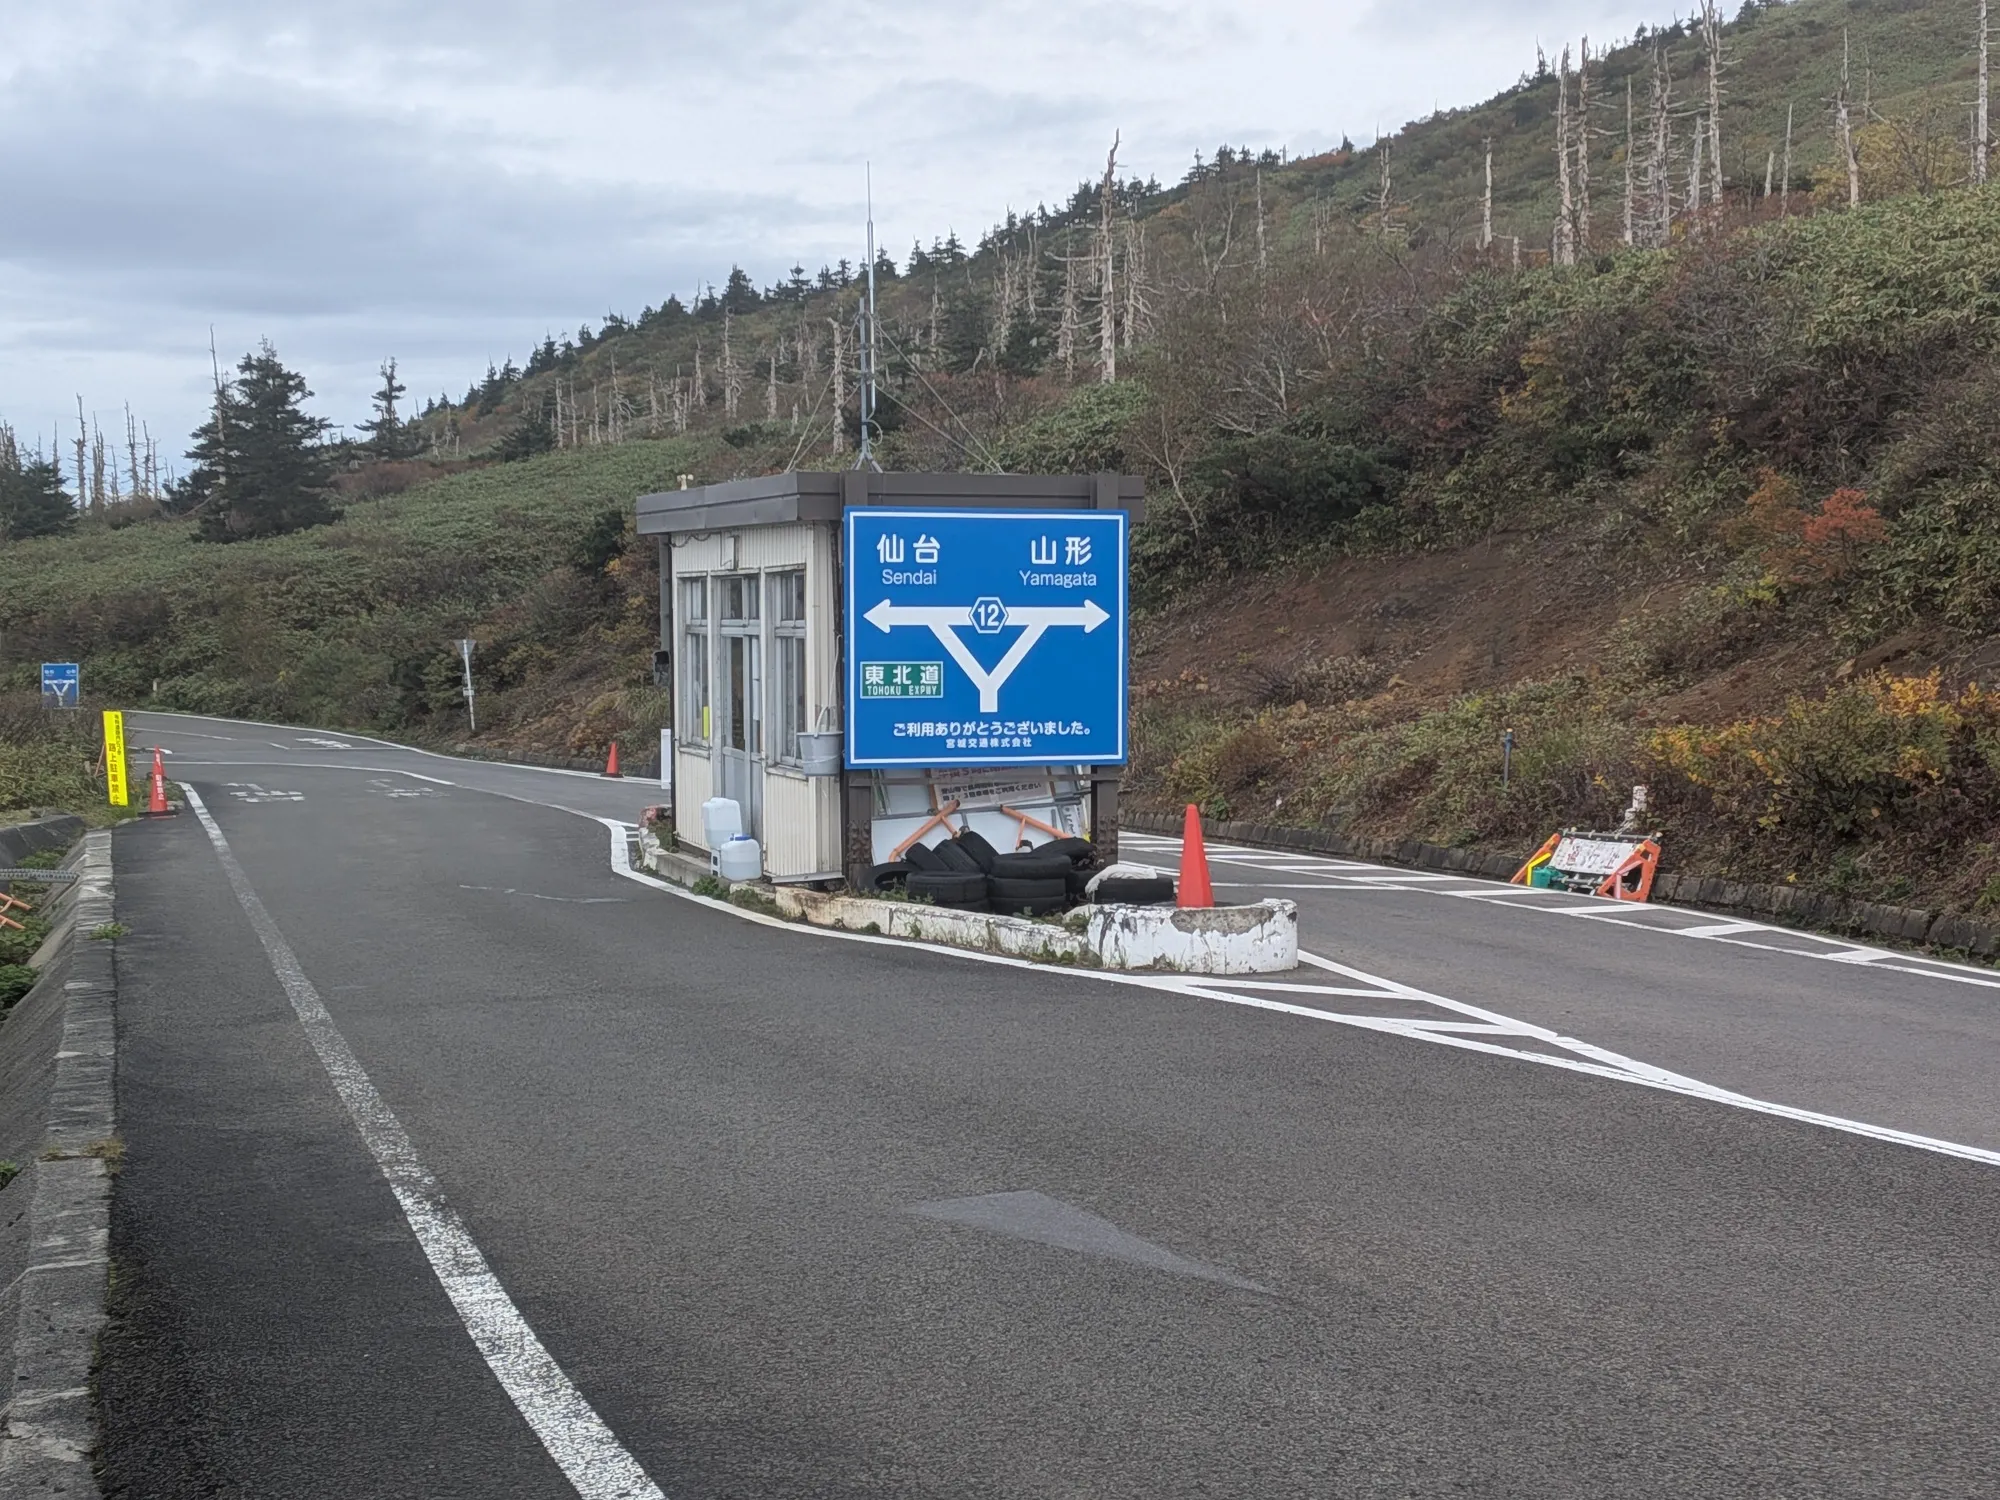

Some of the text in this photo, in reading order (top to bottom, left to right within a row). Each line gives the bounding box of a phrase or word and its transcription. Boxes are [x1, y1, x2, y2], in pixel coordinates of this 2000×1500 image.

[877, 533, 941, 564] 仙台
[1031, 535, 1092, 566] 山形
[882, 569, 937, 585] Sendai
[1019, 571, 1097, 589] Yamagata
[977, 603, 1000, 627] 12
[865, 665, 939, 685] 東北道
[867, 685, 937, 696] TOHOKU EXPWY
[893, 721, 1091, 737] ご利用ありがとうございました。
[946, 737, 1032, 749] 宮城交通株式会社
